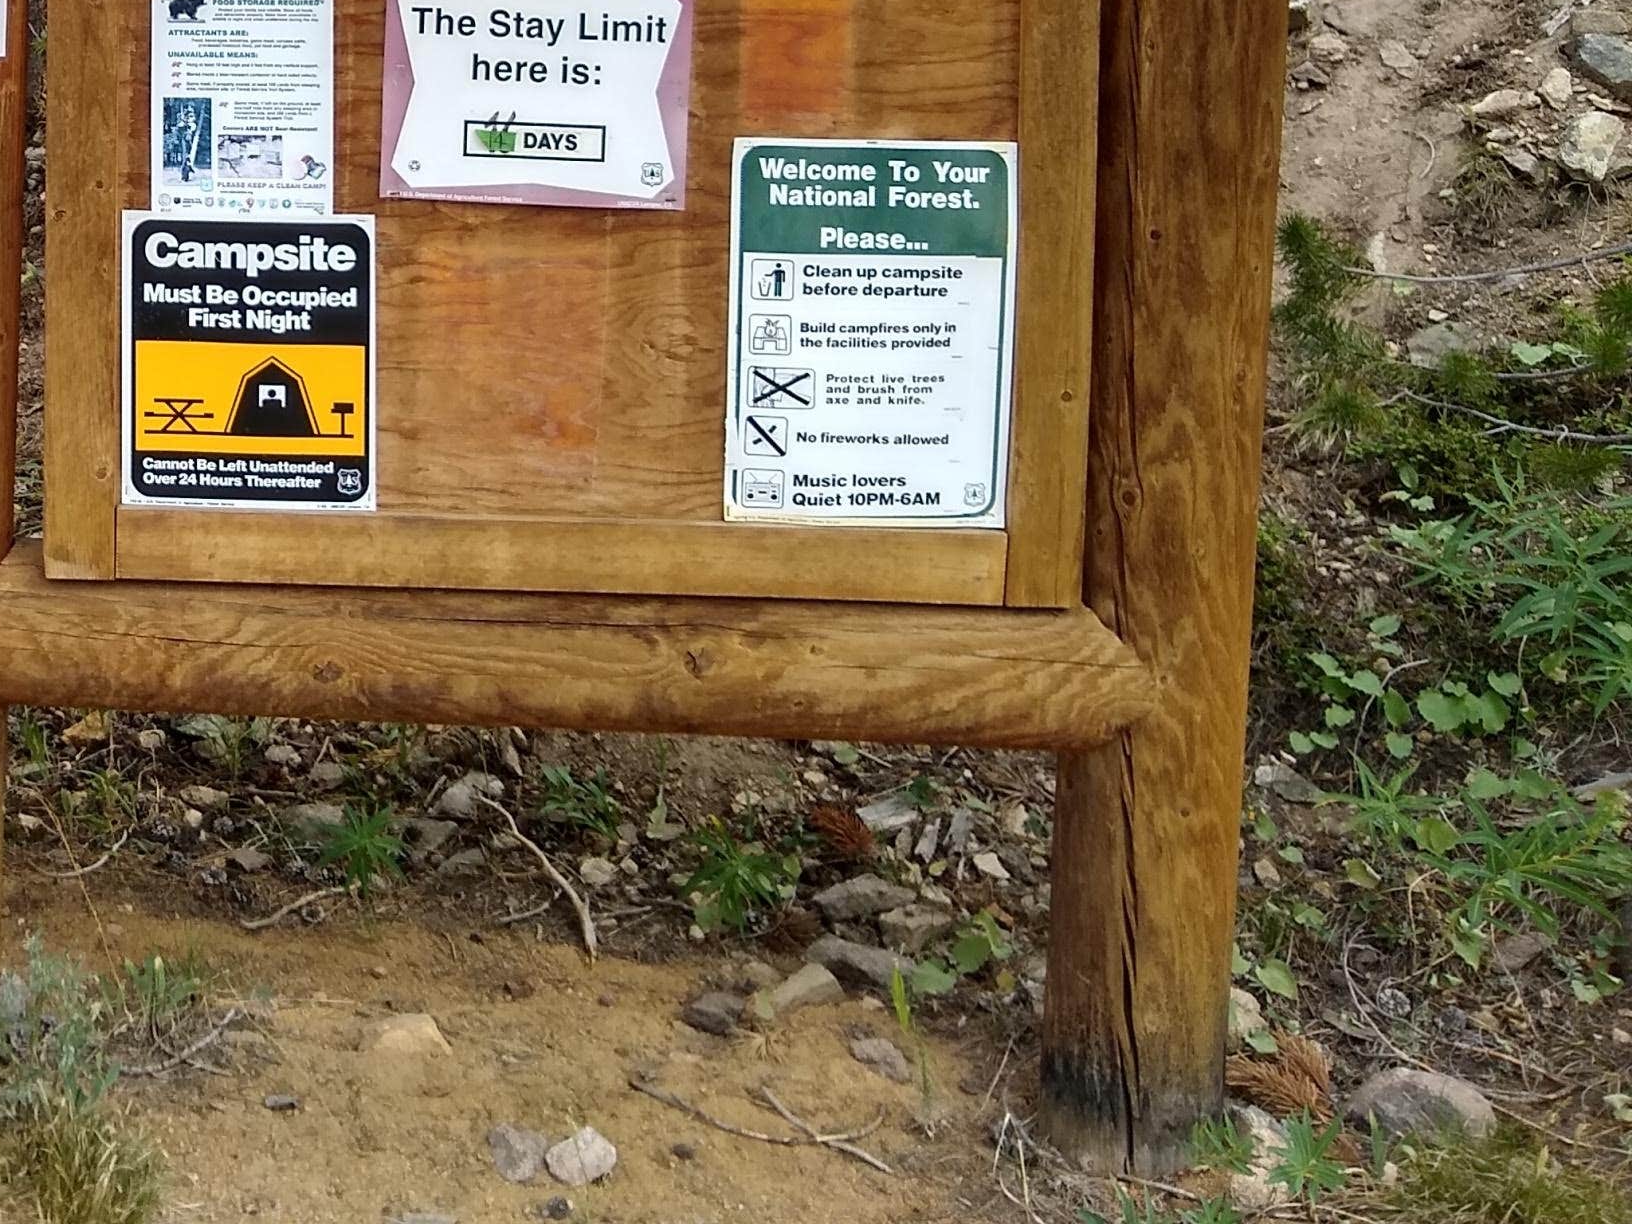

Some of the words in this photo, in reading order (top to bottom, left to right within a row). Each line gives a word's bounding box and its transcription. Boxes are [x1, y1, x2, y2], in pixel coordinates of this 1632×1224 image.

[412, 8, 475, 36] The
[490, 10, 564, 46] Stay
[580, 13, 666, 43] Limit
[472, 54, 547, 82] here
[562, 56, 600, 84] is:
[524, 133, 577, 151] DAYS
[759, 158, 876, 181] Welcome
[888, 161, 920, 181] To
[933, 162, 990, 183] Your
[770, 184, 875, 206] National
[889, 187, 979, 208] Forest.
[821, 227, 928, 250] Please...
[145, 232, 356, 277] Campsite
[803, 265, 851, 277] Clean
[857, 269, 877, 280] up
[882, 266, 962, 281] campsite
[144, 283, 201, 303] Must
[206, 285, 239, 305] Be
[242, 286, 357, 310] Occupied
[803, 283, 857, 295] before
[863, 284, 948, 299] departure
[189, 308, 241, 328] First
[246, 310, 310, 333] Night
[801, 323, 835, 332] Build
[839, 323, 909, 335] campfires
[913, 323, 941, 335] only
[945, 322, 956, 332] in
[800, 338, 822, 347] the
[827, 337, 887, 348] facilities
[892, 337, 950, 350] provided
[826, 374, 874, 383] Protect
[882, 375, 904, 383] live
[826, 385, 850, 393] and
[858, 385, 895, 393] brush
[903, 385, 932, 393] from
[857, 396, 881, 404] and
[888, 396, 924, 404] knife.
[797, 432, 816, 443] No
[821, 432, 889, 444] fireworks
[894, 435, 948, 444] allowed
[143, 457, 194, 470] Cannot
[197, 459, 216, 471] Be
[219, 459, 247, 472] Left
[250, 461, 334, 473] Unattended
[143, 472, 177, 484] Over
[179, 473, 197, 485] 24
[200, 474, 243, 486] Hours
[245, 475, 321, 488] Thereafter
[793, 474, 847, 487] Music
[853, 474, 906, 486] lovers
[793, 493, 841, 506] Quiet
[848, 492, 940, 505] 10PM-6AM
